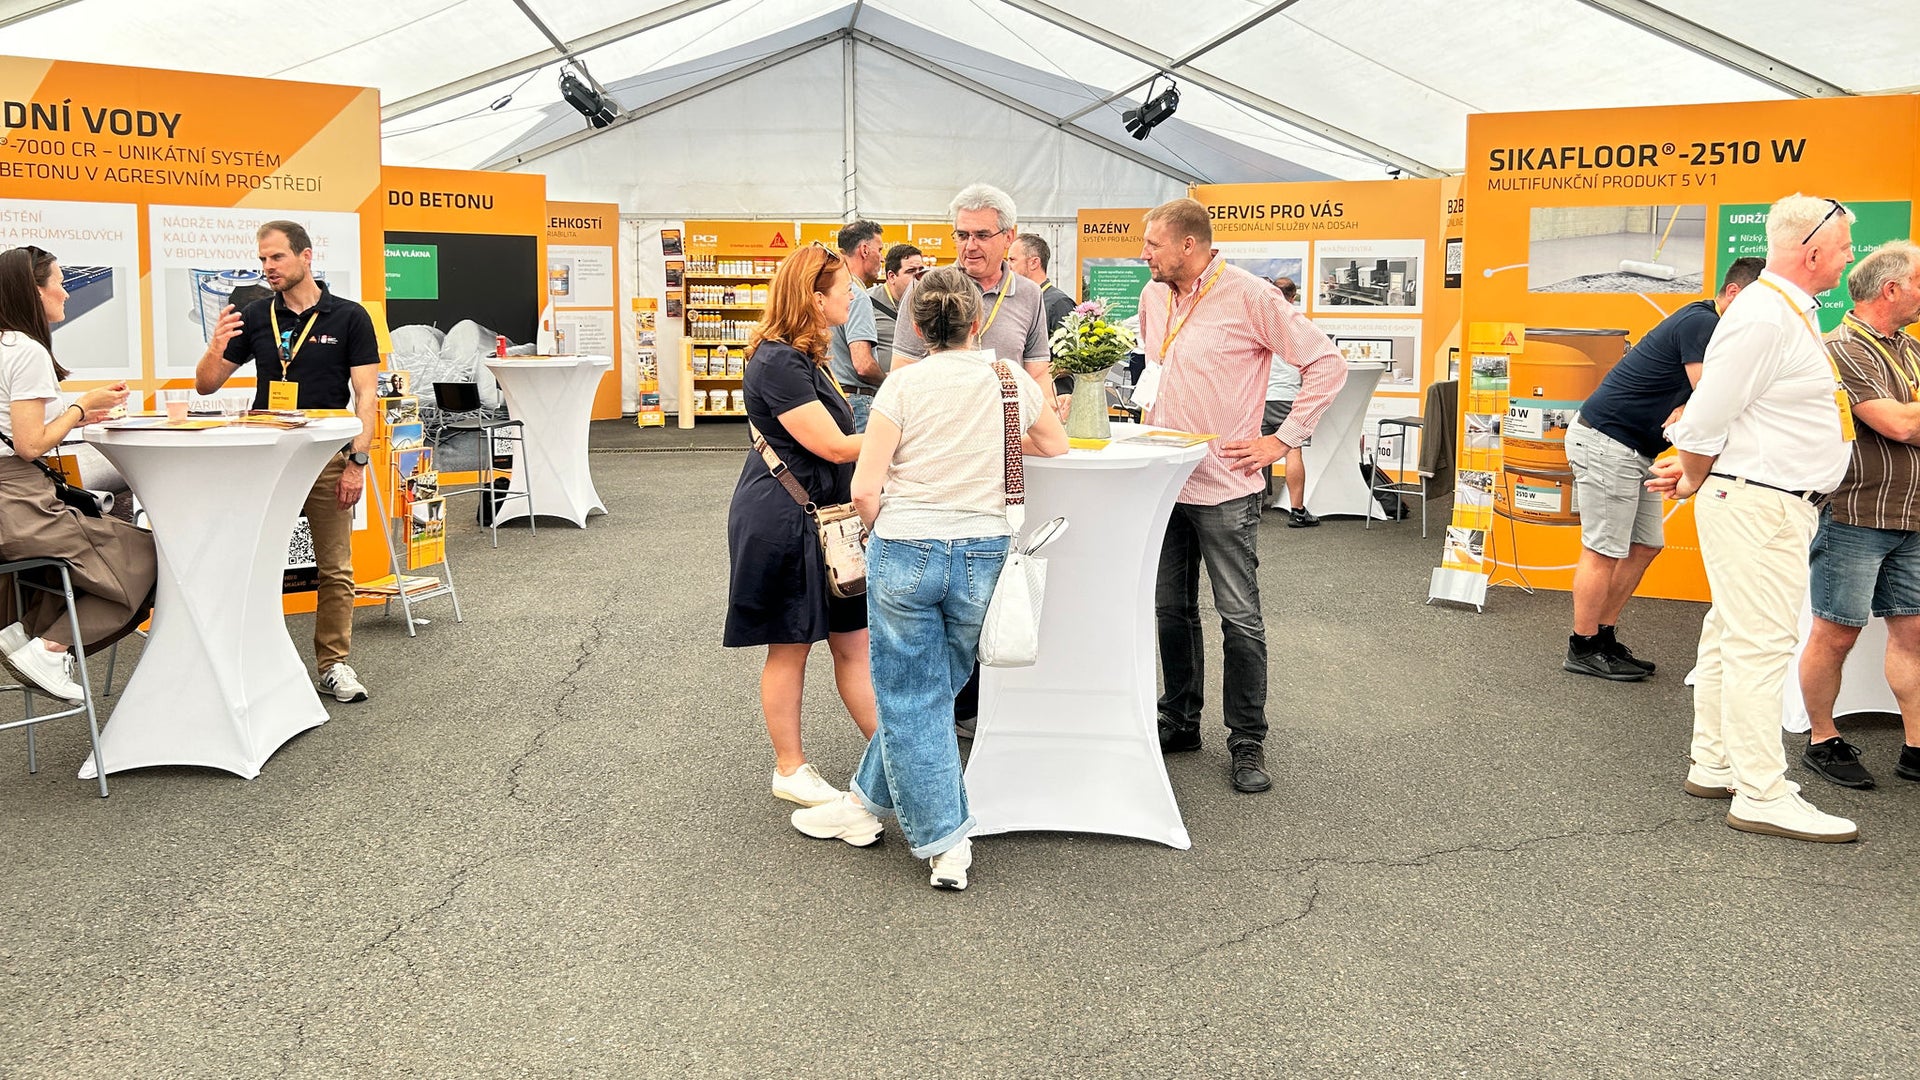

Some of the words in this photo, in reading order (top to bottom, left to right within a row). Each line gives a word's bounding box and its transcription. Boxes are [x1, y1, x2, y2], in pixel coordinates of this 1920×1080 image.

[4, 98, 72, 132] DNÍ
[82, 106, 182, 139] VODY
[72, 142, 97, 157] CR
[119, 144, 206, 164] UNIKÁTNÍ
[211, 150, 281, 168] SYSTÉM
[1771, 138, 1807, 163] W
[0, 162, 79, 181] BETONU
[85, 166, 99, 181] V
[104, 168, 220, 187] AGRESIVNÍM
[226, 173, 322, 192] PROSTŘEDÍ
[1488, 174, 1598, 191] MULTIFUNKČNÍ
[1603, 173, 1677, 189] PRODUKT
[1681, 173, 1690, 187] 5
[1695, 173, 1707, 187] V
[1710, 173, 1717, 187] 1
[388, 190, 414, 206] DO
[420, 191, 494, 210] BETONU
[1448, 198, 1464, 214] B2B
[1207, 205, 1265, 220] SERVIS
[1271, 204, 1304, 219] PRO
[1310, 200, 1344, 217] VÁS
[163, 216, 213, 229] NÁDRŽE
[217, 218, 232, 229] NA
[547, 216, 602, 230] EHKOSTÍ
[1083, 221, 1130, 234] BAZÉNY
[1212, 221, 1274, 232] ROFESIONÁLNÍ
[1276, 221, 1309, 231] SLUŽBY
[1312, 222, 1324, 230] NA
[1327, 221, 1359, 230] DOSAH
[21, 227, 123, 241] PRŮMYSLOVÝCH
[692, 234, 718, 243] PCI
[918, 237, 942, 246] PCI
[401, 249, 431, 258] VLÁKNA
[1518, 409, 1529, 418] W
